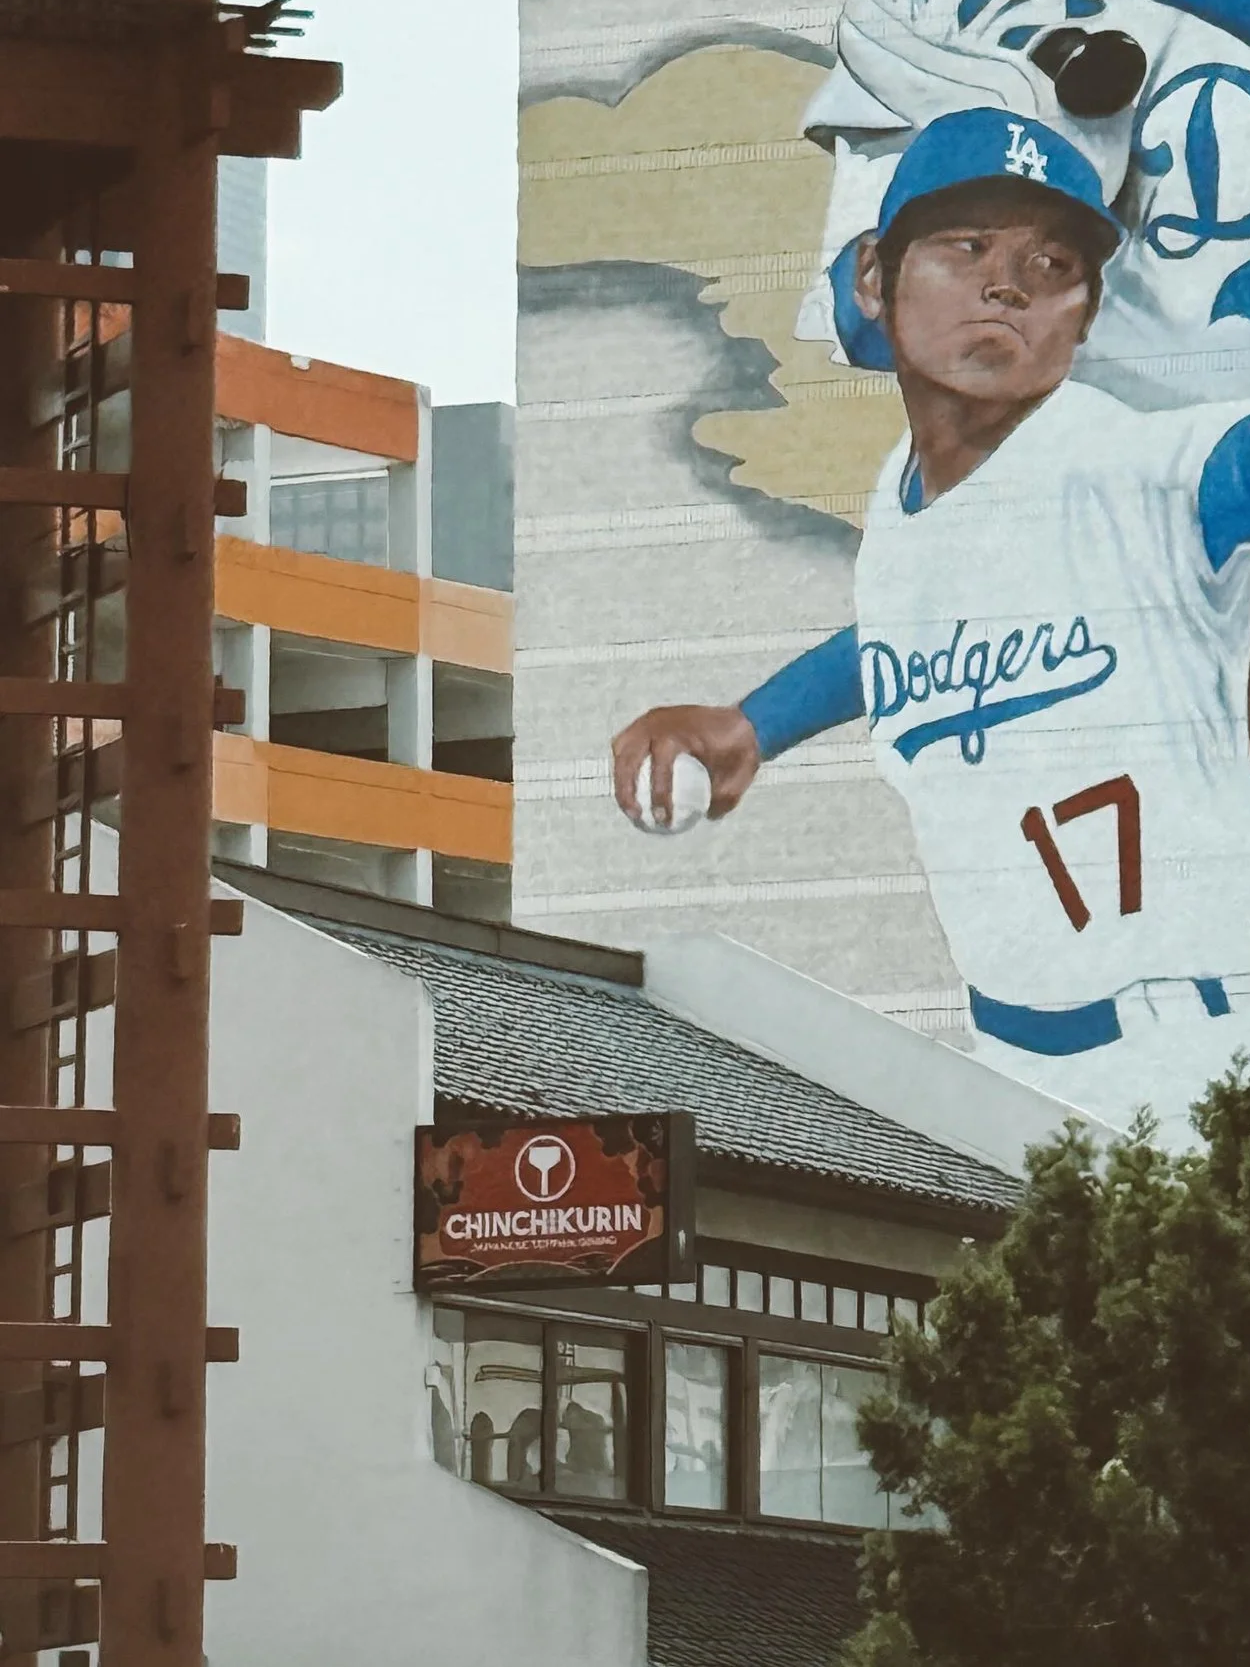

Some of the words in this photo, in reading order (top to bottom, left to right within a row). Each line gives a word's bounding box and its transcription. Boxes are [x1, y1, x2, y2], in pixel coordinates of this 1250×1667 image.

[1005, 123, 1048, 183] LA
[859, 615, 1117, 765] Dodgers
[1020, 773, 1141, 932] 17
[445, 1203, 642, 1240] CHINCHIKURIN
